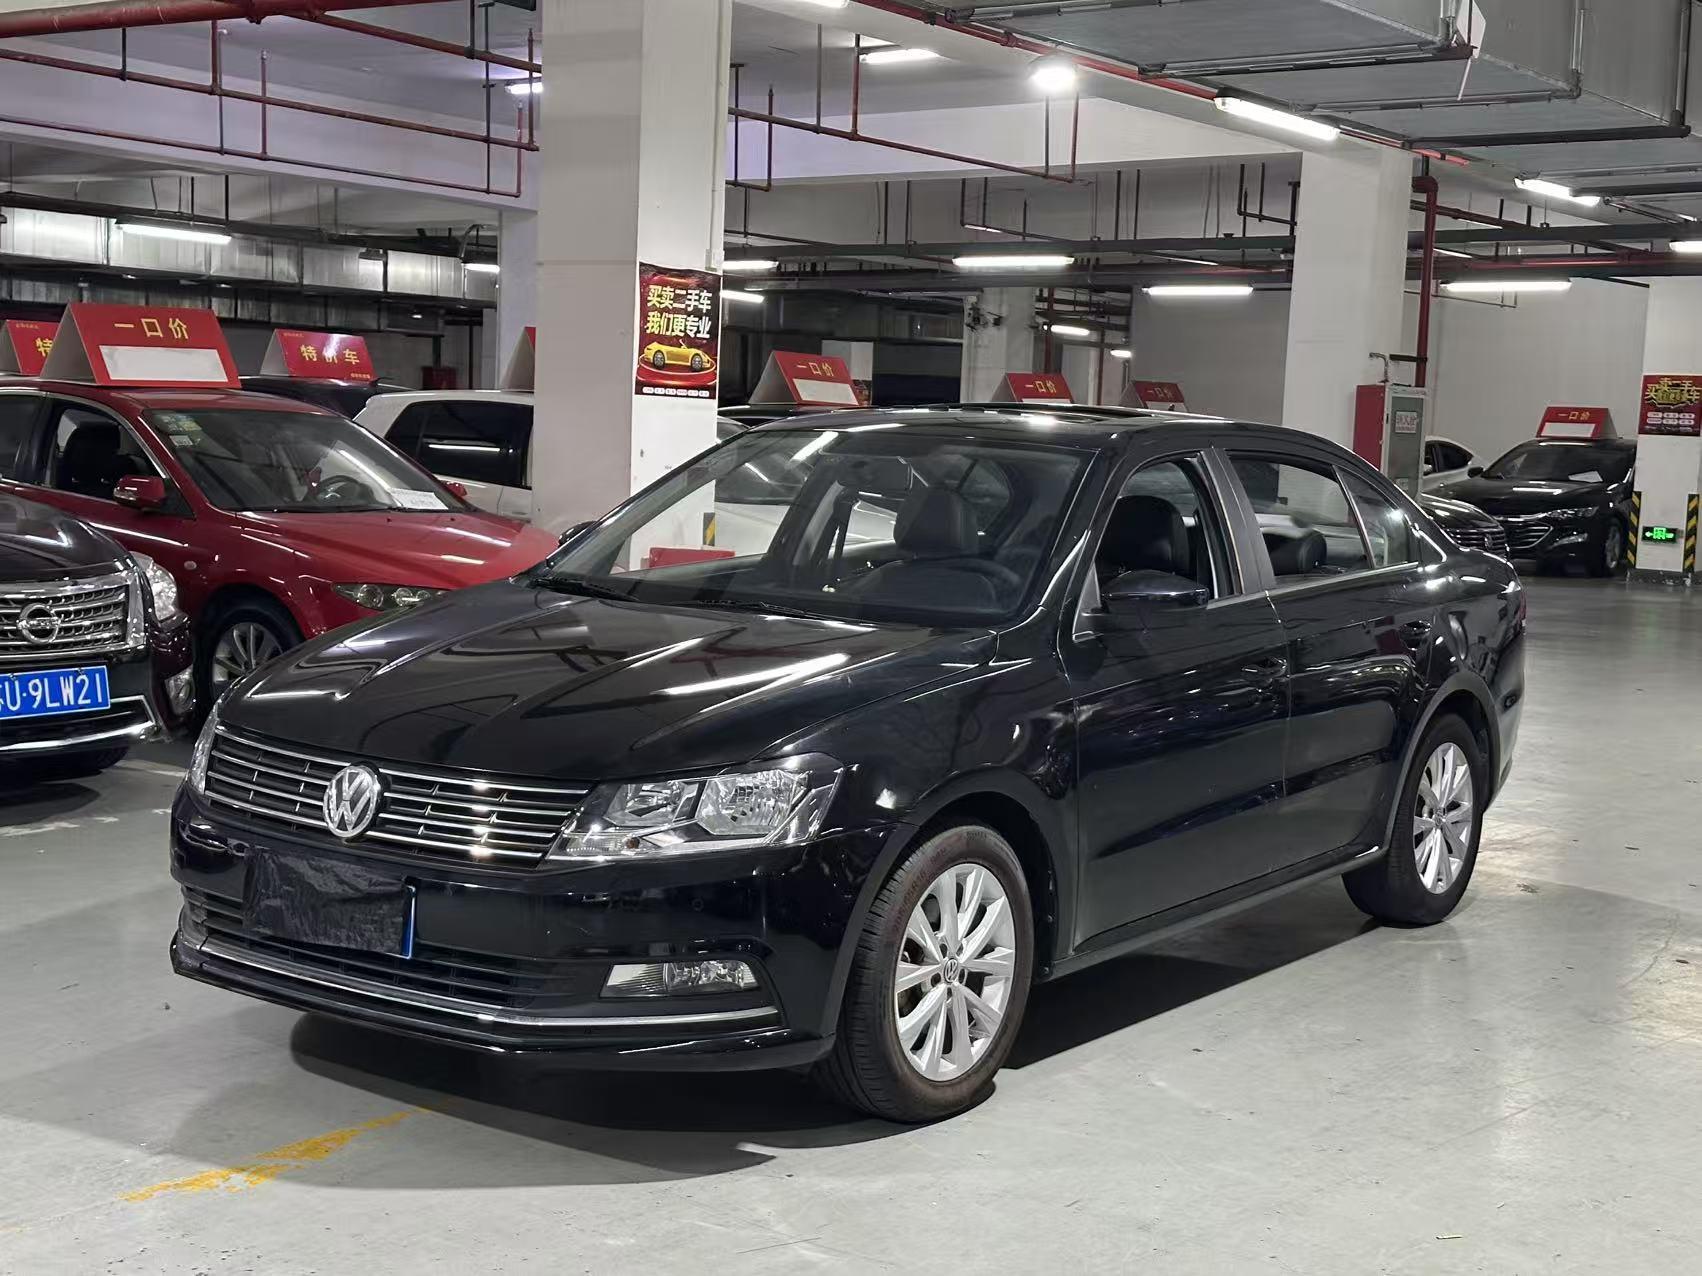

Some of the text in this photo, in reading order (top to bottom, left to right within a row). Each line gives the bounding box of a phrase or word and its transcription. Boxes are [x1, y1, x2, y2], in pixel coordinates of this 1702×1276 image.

[646, 284, 712, 313] 买卖二手车
[114, 317, 189, 339] 一口价
[645, 311, 711, 339] 我们更专业
[796, 362, 834, 377] 一口价
[1025, 380, 1057, 393] 一口价
[1557, 411, 1590, 421] 一口价
[0, 673, 103, 711] U·9LW21
